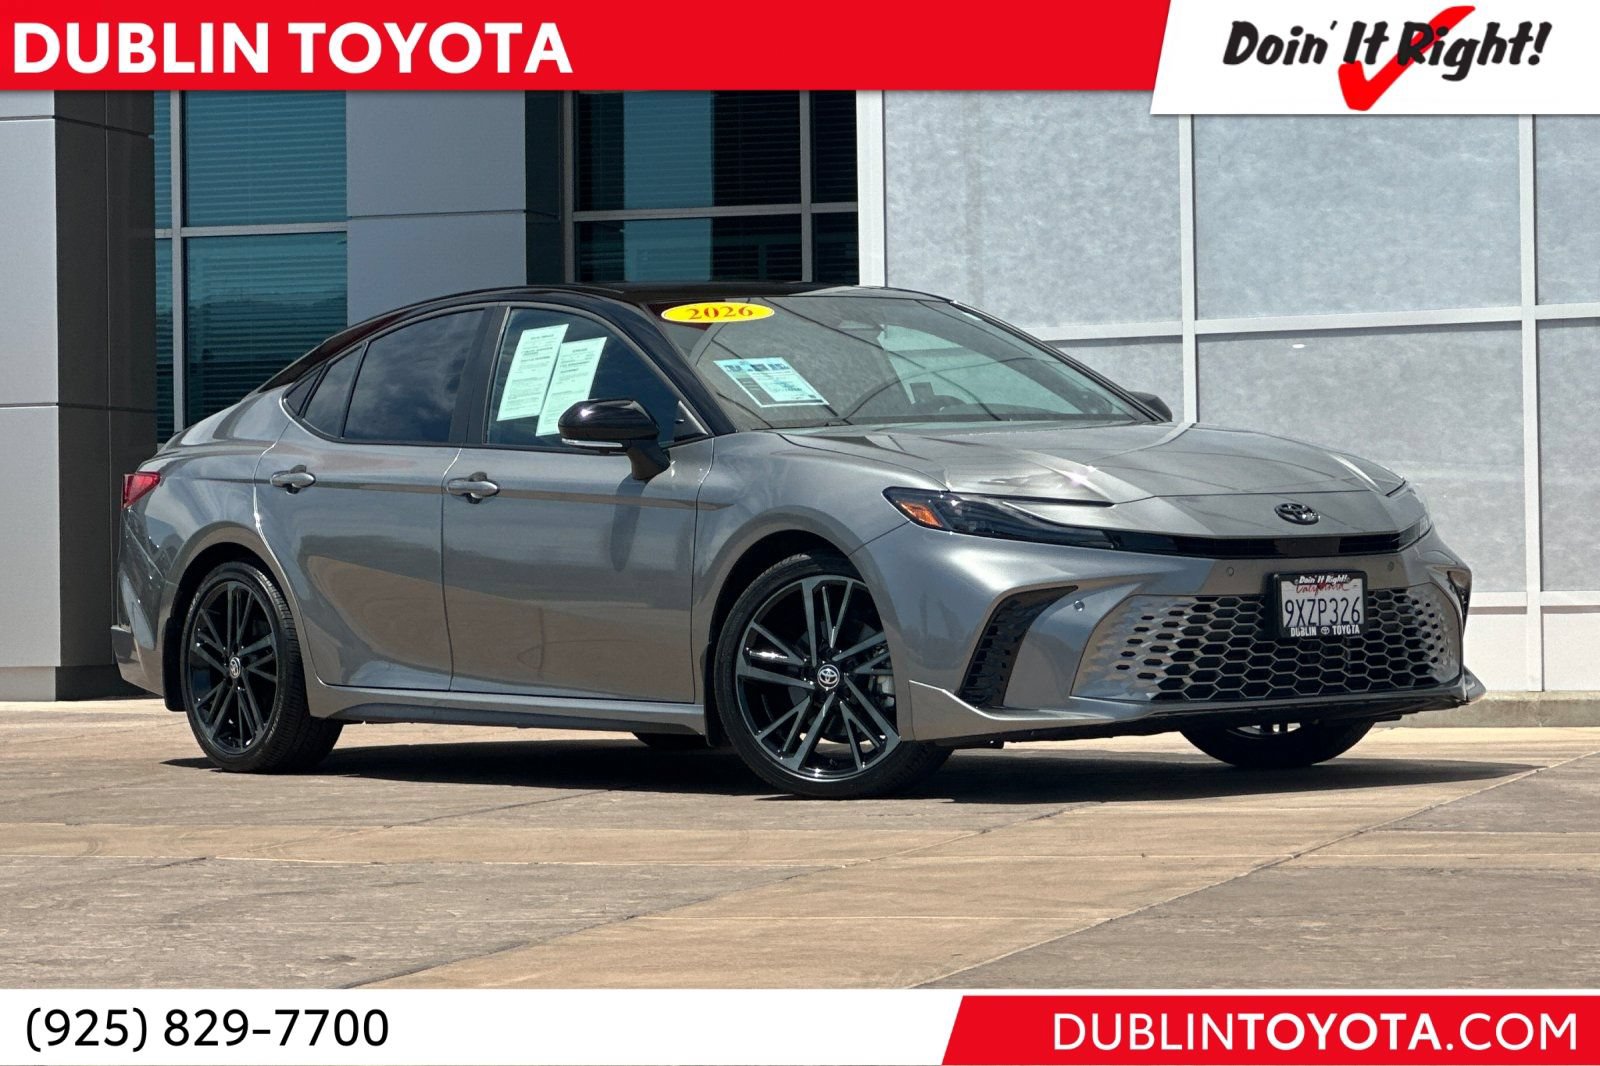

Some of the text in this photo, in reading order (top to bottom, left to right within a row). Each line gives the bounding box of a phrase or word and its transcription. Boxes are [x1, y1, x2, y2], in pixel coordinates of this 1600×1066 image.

[686, 305, 754, 320] 2026
[1296, 583, 1350, 596] Califrnia
[1285, 597, 1360, 627] 9XZP326
[1290, 624, 1360, 637] DUBLIN TOYOTA
